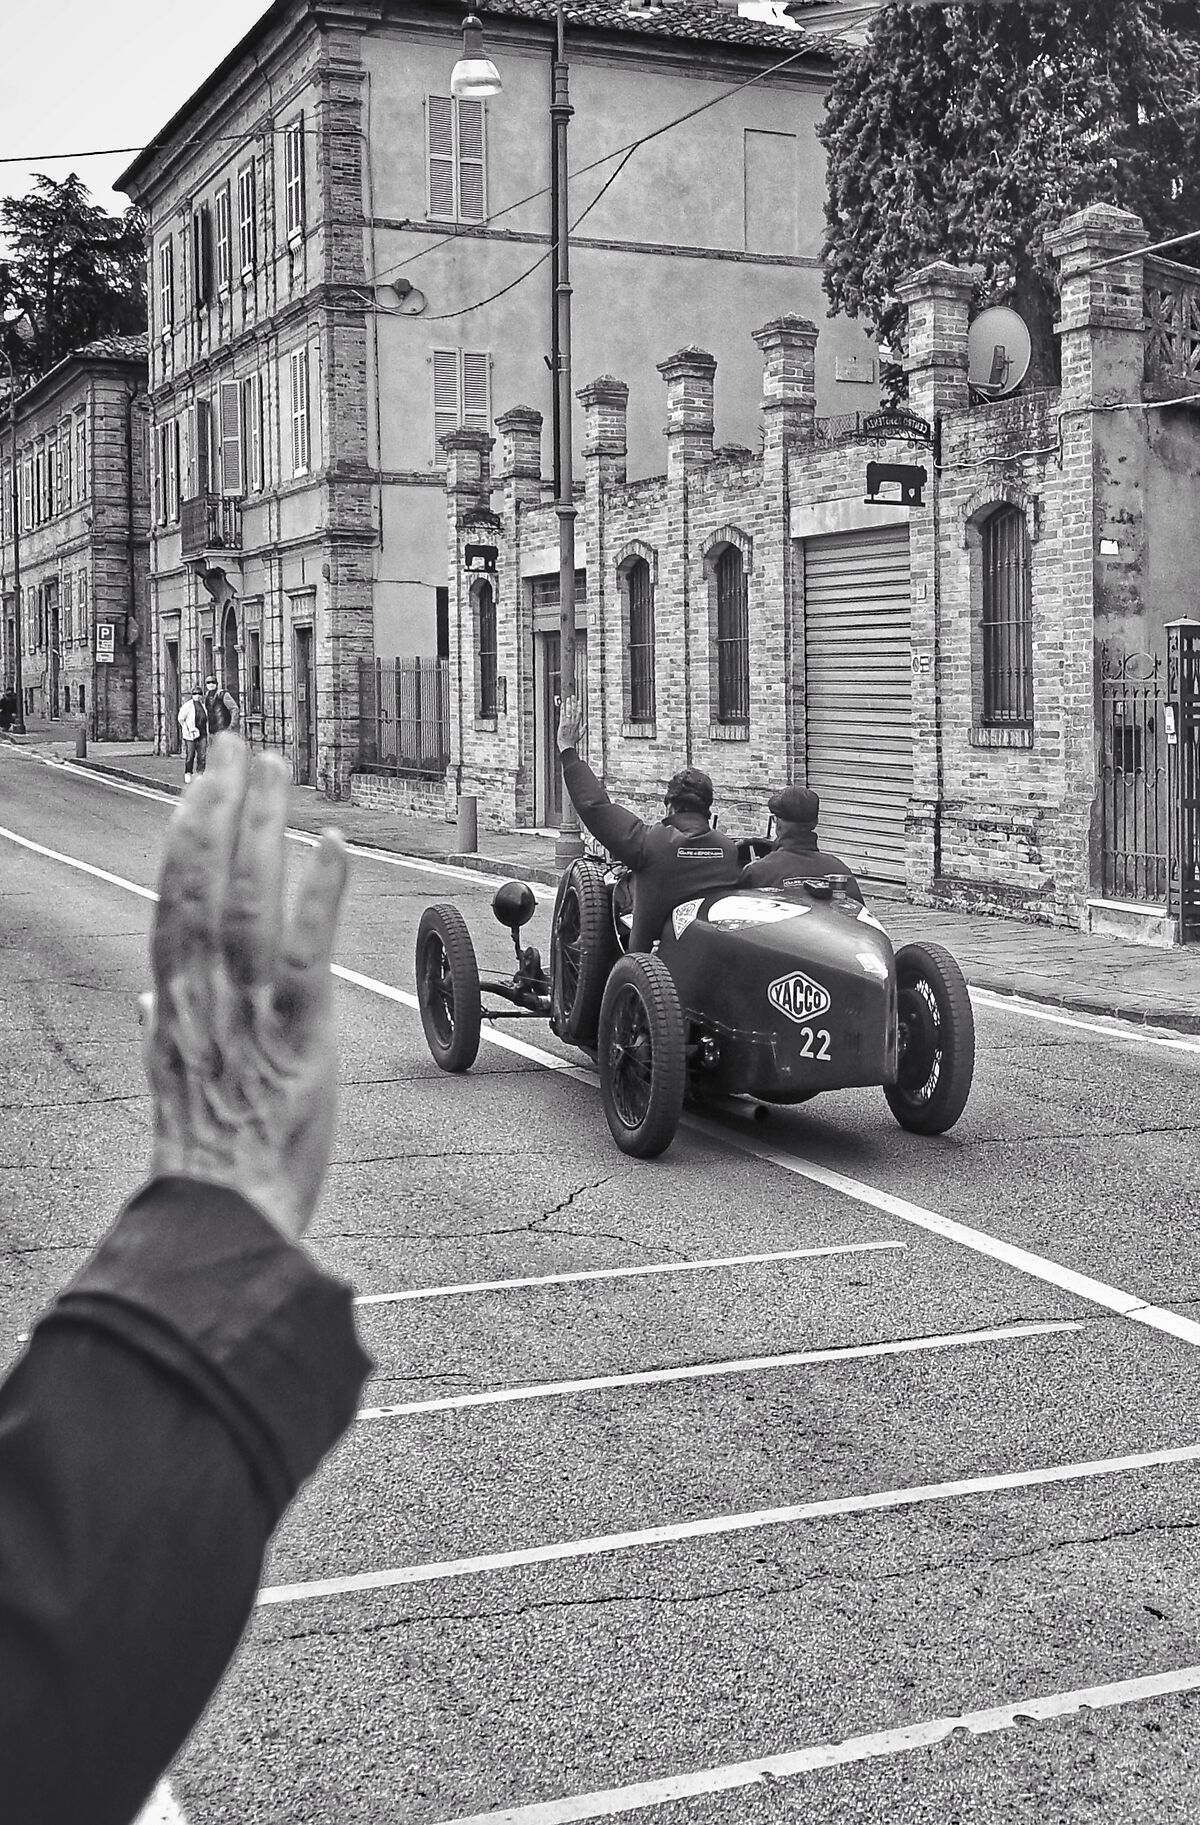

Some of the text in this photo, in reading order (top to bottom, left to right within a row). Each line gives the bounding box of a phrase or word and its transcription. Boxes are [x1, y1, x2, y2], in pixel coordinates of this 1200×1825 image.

[101, 628, 110, 639] P
[774, 978, 821, 1015] YACCO
[799, 1026, 832, 1061] 22
